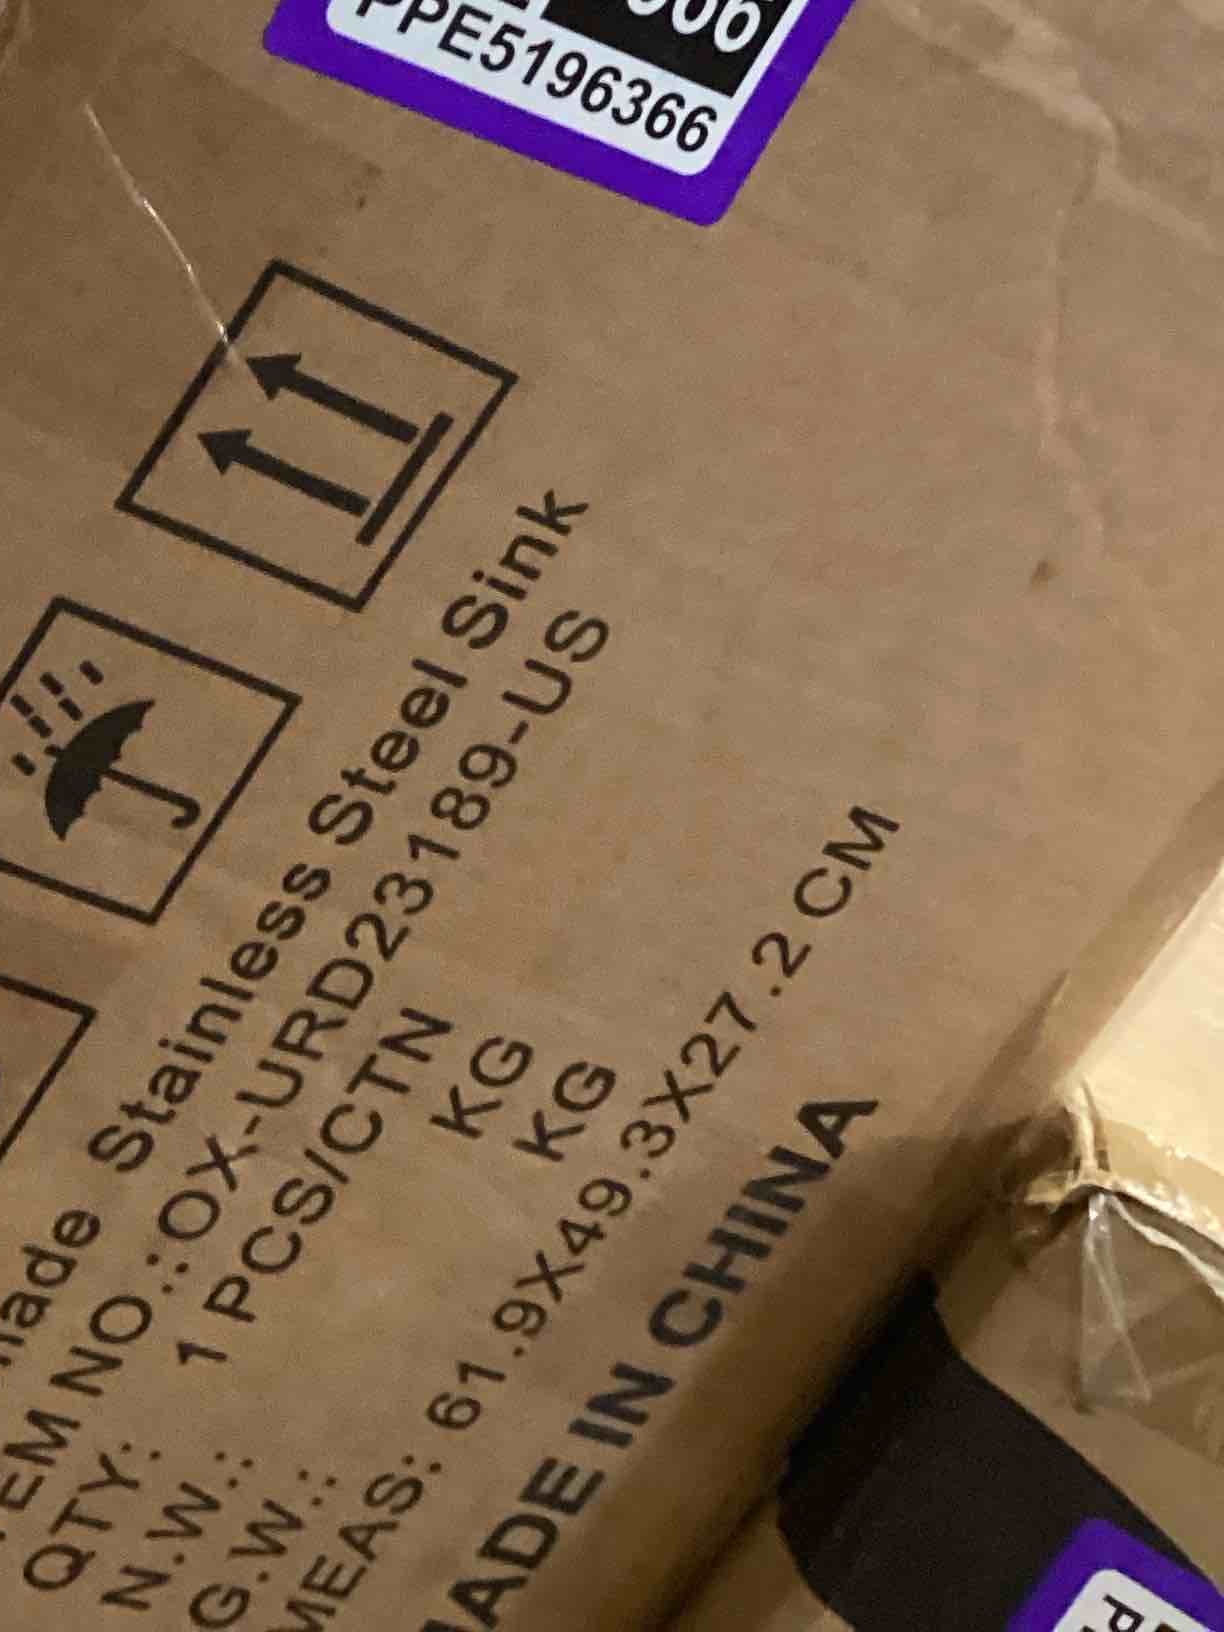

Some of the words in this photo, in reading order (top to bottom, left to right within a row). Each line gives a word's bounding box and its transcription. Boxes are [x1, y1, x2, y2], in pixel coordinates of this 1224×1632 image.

[88, 861, 333, 1173] Stainless
[307, 658, 469, 846] Steel
[441, 489, 590, 649] Sink
[792, 804, 901, 921] CM
[430, 1035, 535, 1139] KG
[512, 1061, 617, 1163] KG
[22, 1441, 162, 1592] QTY:
[175, 1340, 229, 1367] 1
[202, 1006, 455, 1324] PCS/CTN
[416, 1456, 605, 1632] ADE
[569, 1362, 677, 1451] IN
[648, 1099, 880, 1350] CHINA
